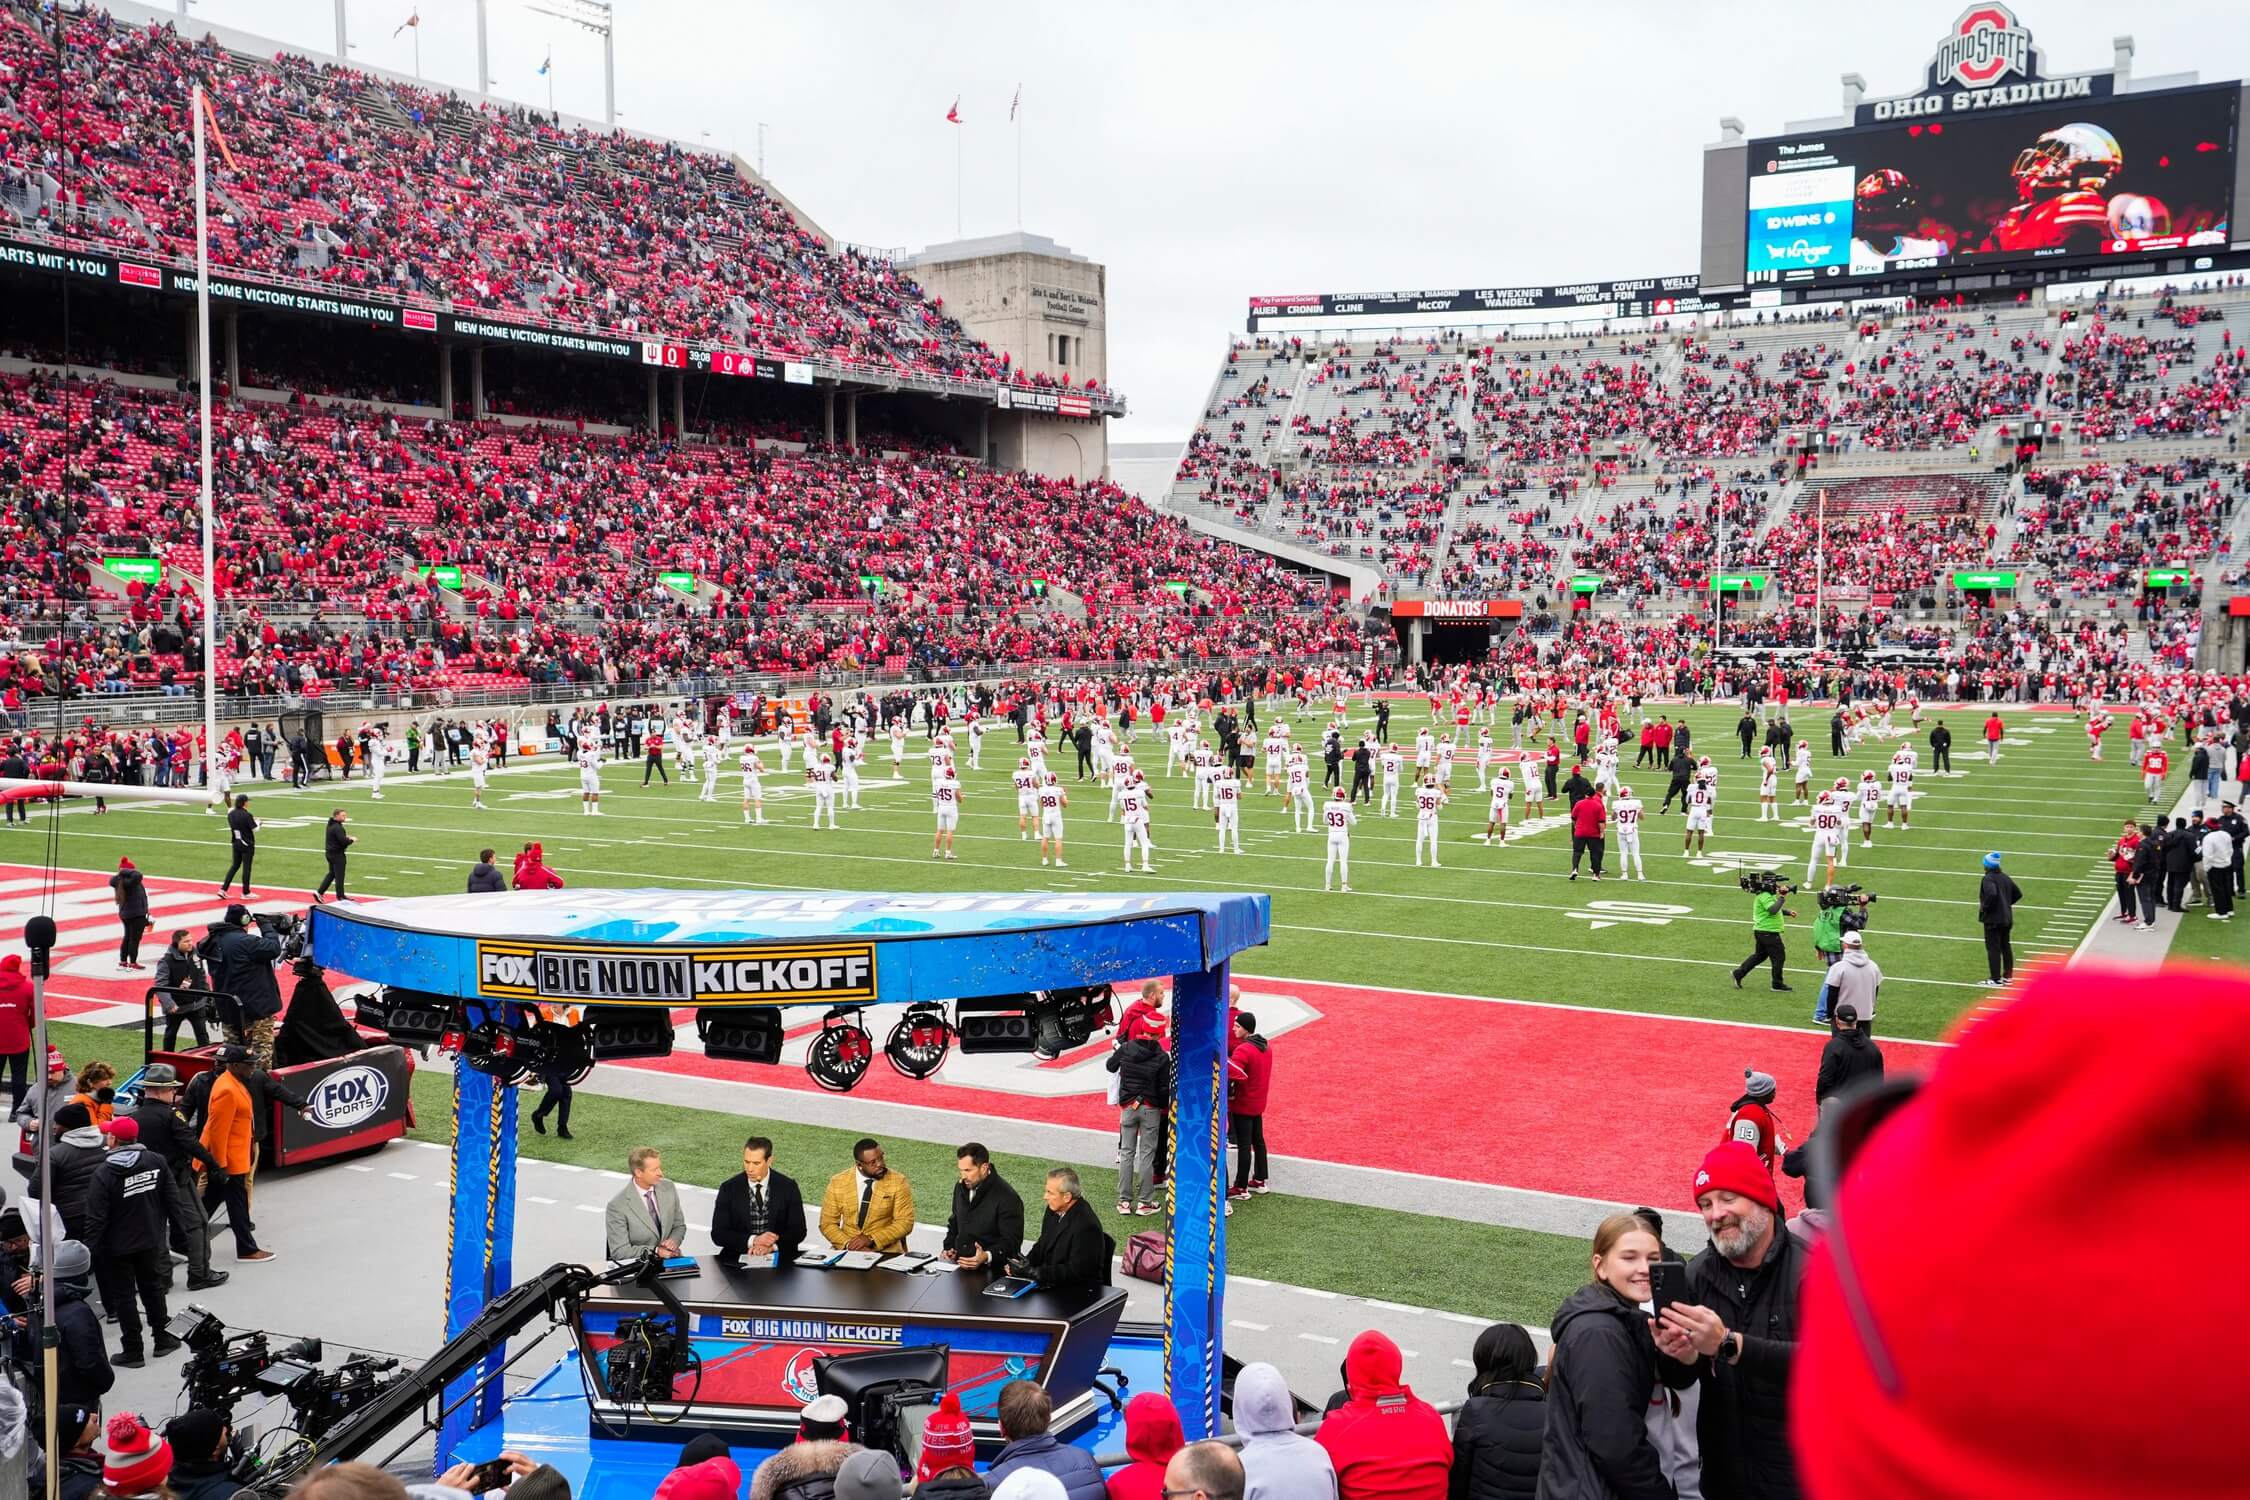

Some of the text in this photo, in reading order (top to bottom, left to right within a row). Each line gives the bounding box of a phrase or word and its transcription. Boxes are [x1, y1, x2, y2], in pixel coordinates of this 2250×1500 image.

[1939, 27, 2025, 84] OHIO STATE
[1874, 77, 2092, 120] OHIO STADIUM
[1778, 143, 1825, 155] The James
[37, 252, 75, 271] WITH
[77, 258, 107, 276] YOU
[1855, 264, 1879, 273] Pre
[1612, 279, 1655, 292] COVELLI
[1661, 276, 1698, 287] WELLS
[1424, 289, 1460, 298] DIAMOND
[1475, 288, 1543, 300] LES WEXNER
[1555, 285, 1599, 297] HARMON
[1575, 291, 1636, 304] WOLFE FDN
[174, 275, 199, 291] NEW
[208, 281, 242, 299] HOME
[244, 287, 295, 307] VICTORY
[296, 296, 339, 314] STARTS
[340, 303, 369, 318] WITH
[370, 308, 394, 321] YOU
[1484, 297, 1535, 307] WANDELL
[1047, 301, 1067, 312] Football
[1252, 301, 1450, 315] AUER CRONIN CLINE McCOY
[1680, 302, 1720, 311] MARYLAND
[454, 320, 630, 356] NEW HOME VICTORY STARTS WITH YOU
[668, 348, 677, 363] 0
[689, 350, 711, 363] 39:08
[723, 356, 733, 371] 0
[1424, 601, 1480, 617] DONATOS
[1267, 745, 1280, 755] 44
[1113, 762, 1126, 773] 48
[1387, 761, 1394, 772] 2
[1015, 777, 1030, 789] 34
[1291, 771, 1302, 783] 15
[1894, 771, 1907, 782] 19
[937, 788, 952, 801] 45
[1221, 788, 1233, 800] 16
[1496, 787, 1504, 798] 5
[1695, 791, 1704, 804] 0
[1866, 789, 1878, 801] 13
[1124, 798, 1137, 811] 15
[1419, 796, 1434, 809] 36
[1327, 812, 1345, 827] 93
[1620, 810, 1637, 823] 97
[1817, 815, 1836, 829] 80
[482, 954, 870, 995] FOX BIG NOON KICKOFF
[324, 1074, 371, 1109] FOX
[326, 1098, 373, 1119] SPORTS
[1740, 1127, 1753, 1140] 13
[125, 1169, 160, 1187] BEST
[722, 1319, 902, 1341] FOX BIG NOON KICKOFF
